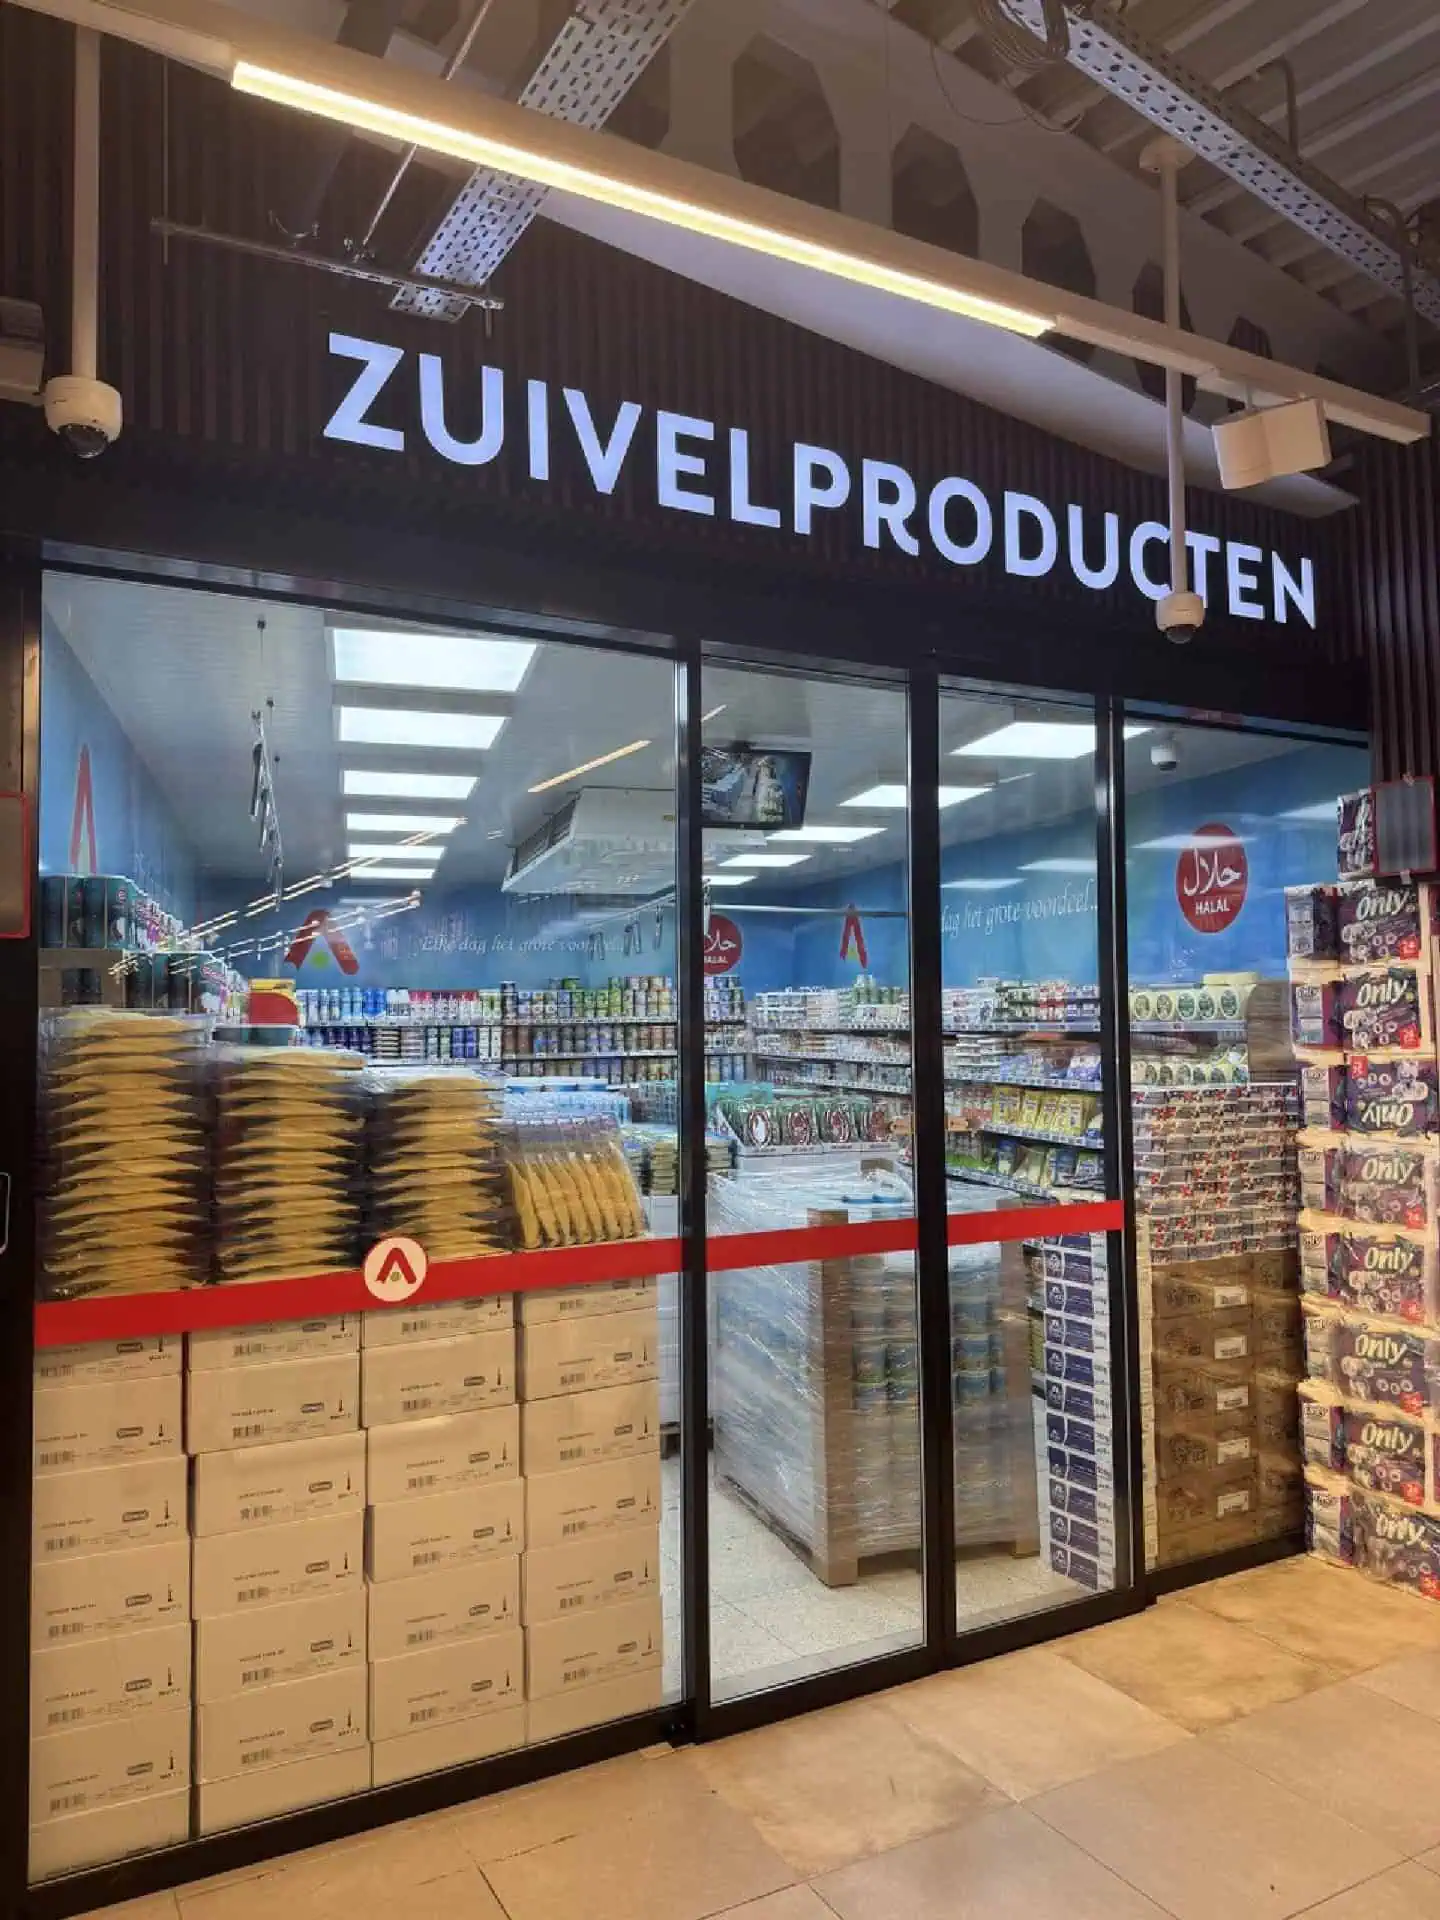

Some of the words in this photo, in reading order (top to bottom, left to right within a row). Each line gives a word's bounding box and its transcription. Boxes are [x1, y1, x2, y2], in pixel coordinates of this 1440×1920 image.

[323, 332, 1316, 629] ZUIVELPRODUCTEN
[1183, 847, 1241, 896] حلال
[1195, 897, 1230, 915] HALAL
[1356, 889, 1410, 920] Only
[1356, 978, 1408, 1006] Only
[1361, 1101, 1414, 1128] Only
[1361, 1156, 1416, 1185] Only
[1364, 1247, 1414, 1276] Only
[1354, 1333, 1408, 1365] Only
[1361, 1422, 1413, 1454] Only
